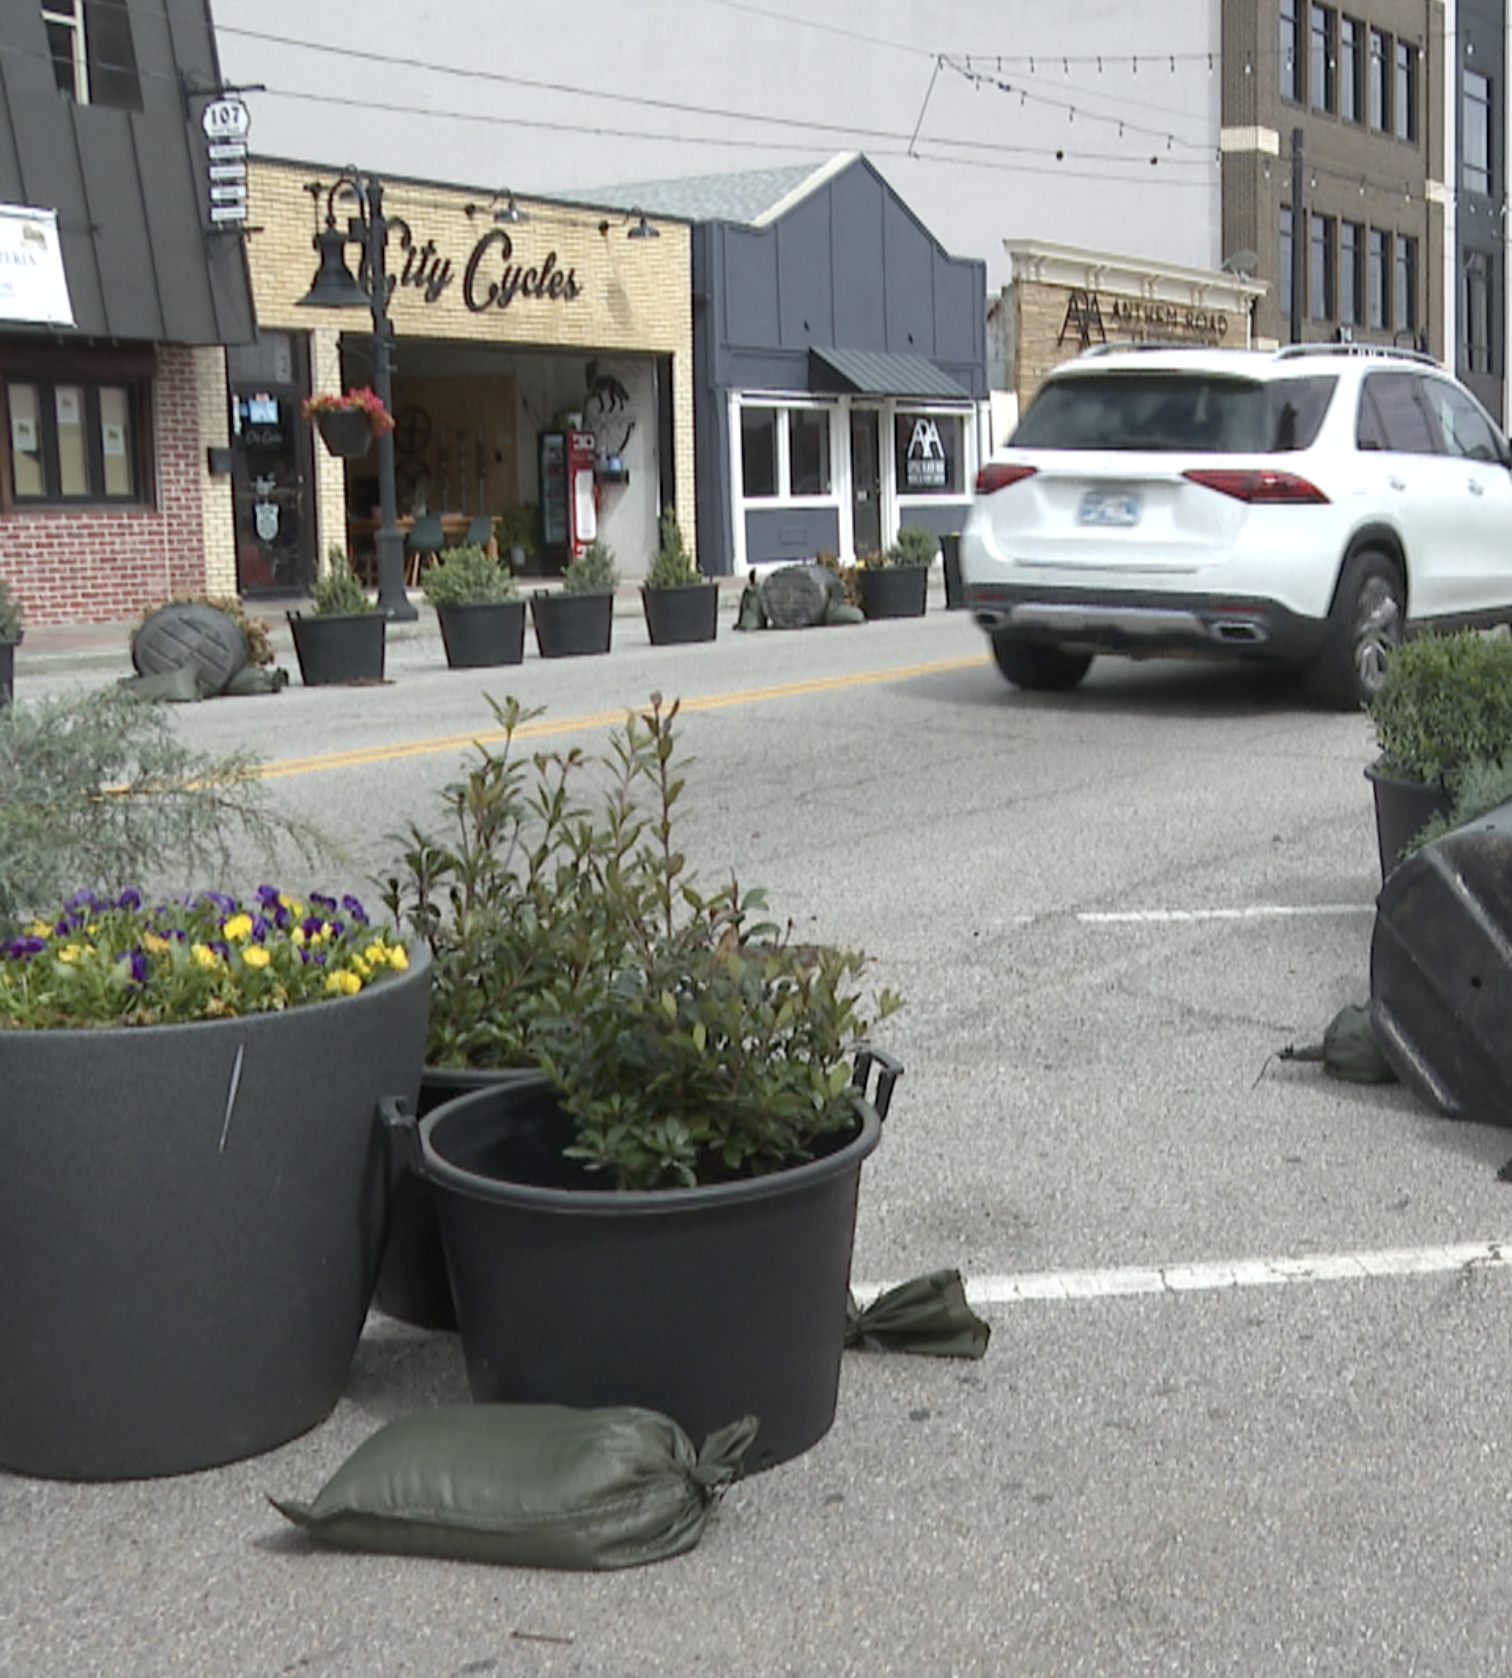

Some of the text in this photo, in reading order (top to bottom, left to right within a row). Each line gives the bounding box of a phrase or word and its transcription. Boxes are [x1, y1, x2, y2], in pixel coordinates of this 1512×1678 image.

[210, 105, 240, 126] 107
[359, 216, 583, 312] City Cycles
[1110, 299, 1229, 337] ANTHEM ROAD
